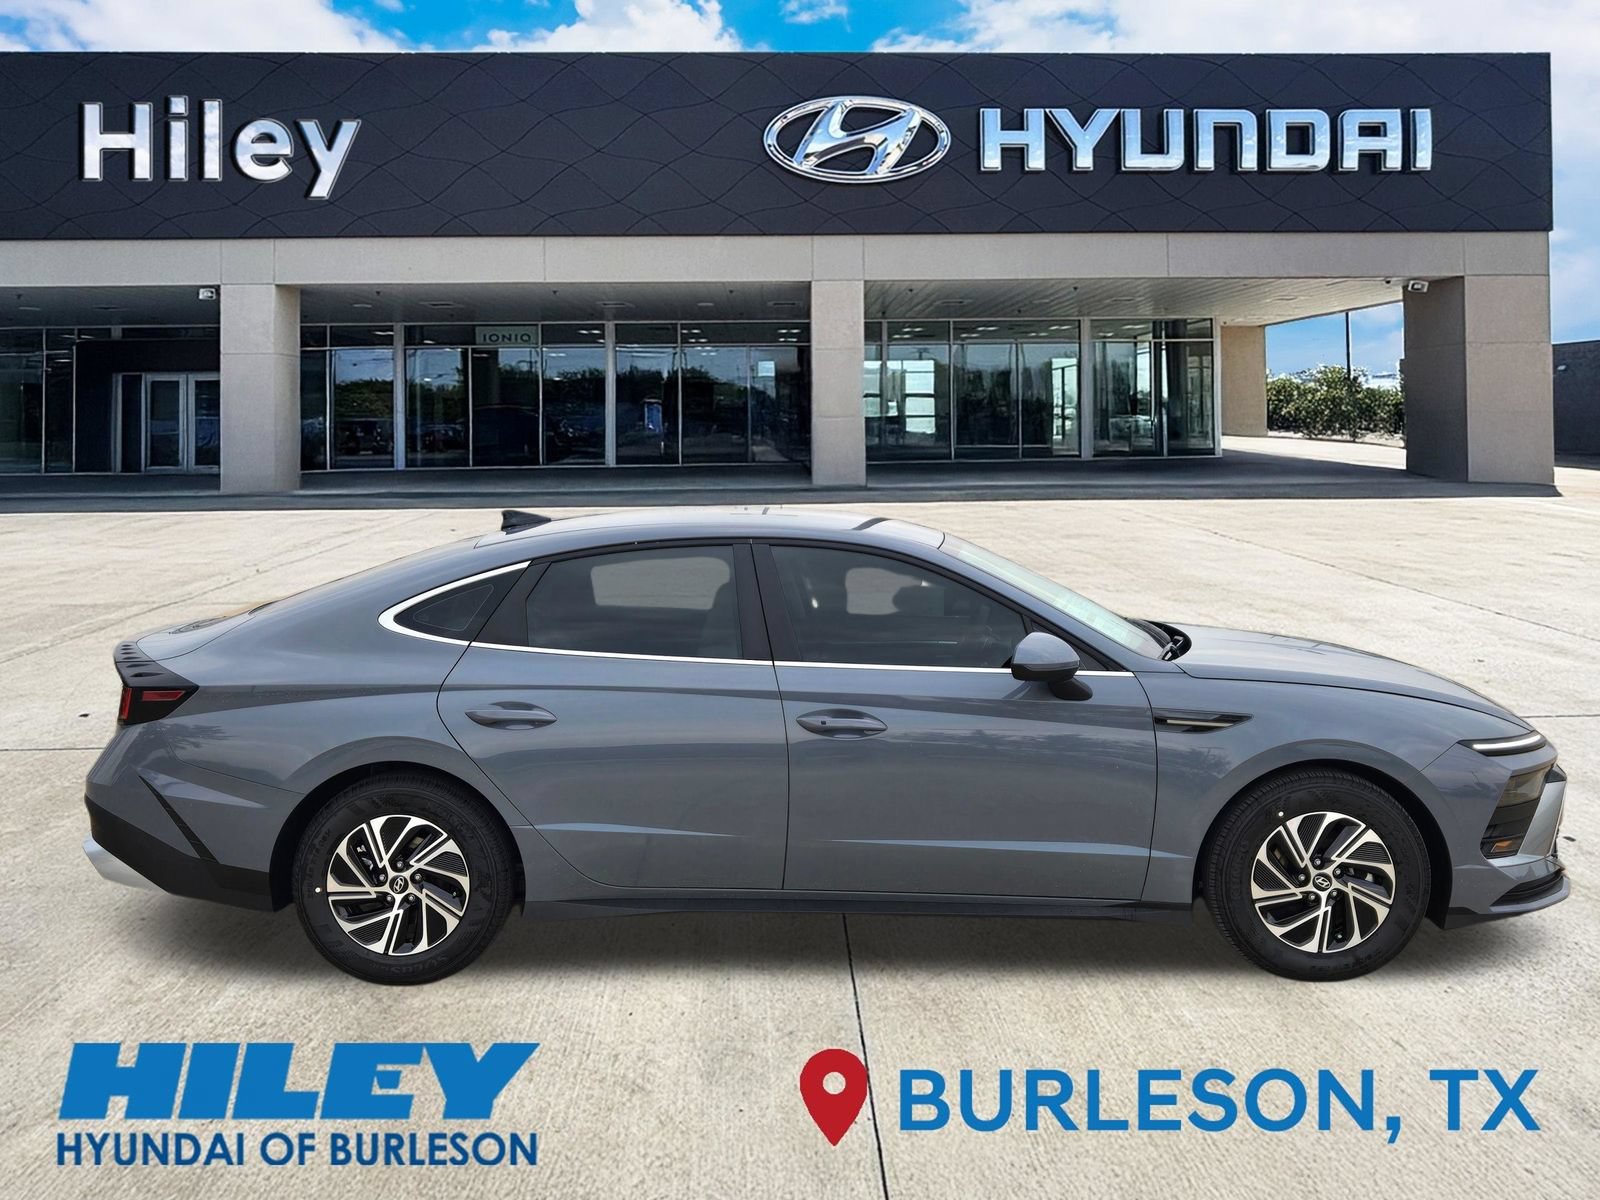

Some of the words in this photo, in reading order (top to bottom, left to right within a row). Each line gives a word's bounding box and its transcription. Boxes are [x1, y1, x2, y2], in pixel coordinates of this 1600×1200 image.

[80, 95, 362, 200] Hiley
[979, 107, 1434, 172] HYUNDAI
[482, 333, 532, 343] IONIQ
